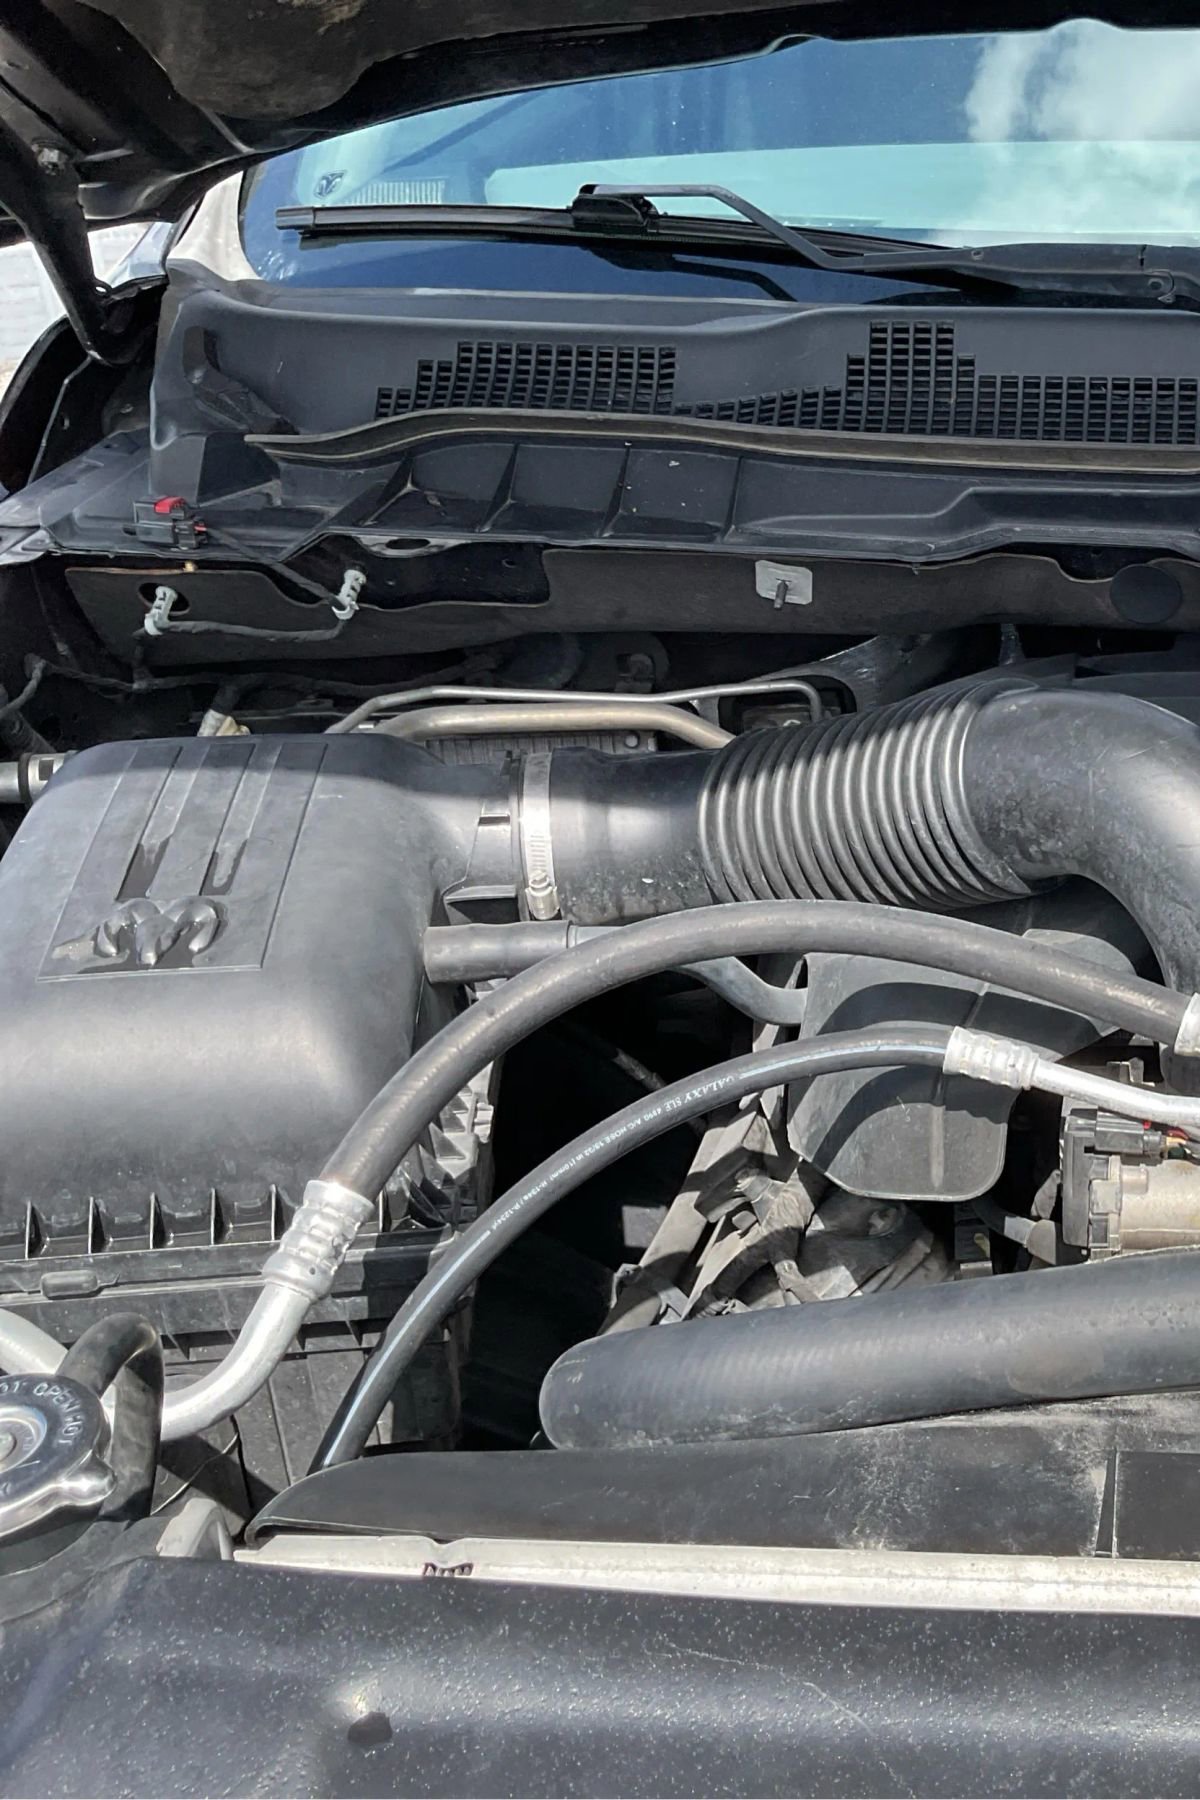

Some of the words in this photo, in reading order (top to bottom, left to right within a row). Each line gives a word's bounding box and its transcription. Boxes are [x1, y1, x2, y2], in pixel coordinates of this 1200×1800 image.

[627, 1118, 641, 1130] A/C
[604, 1126, 627, 1144] HOSE
[0, 1381, 27, 1396] OT
[33, 1381, 81, 1412] OPEN
